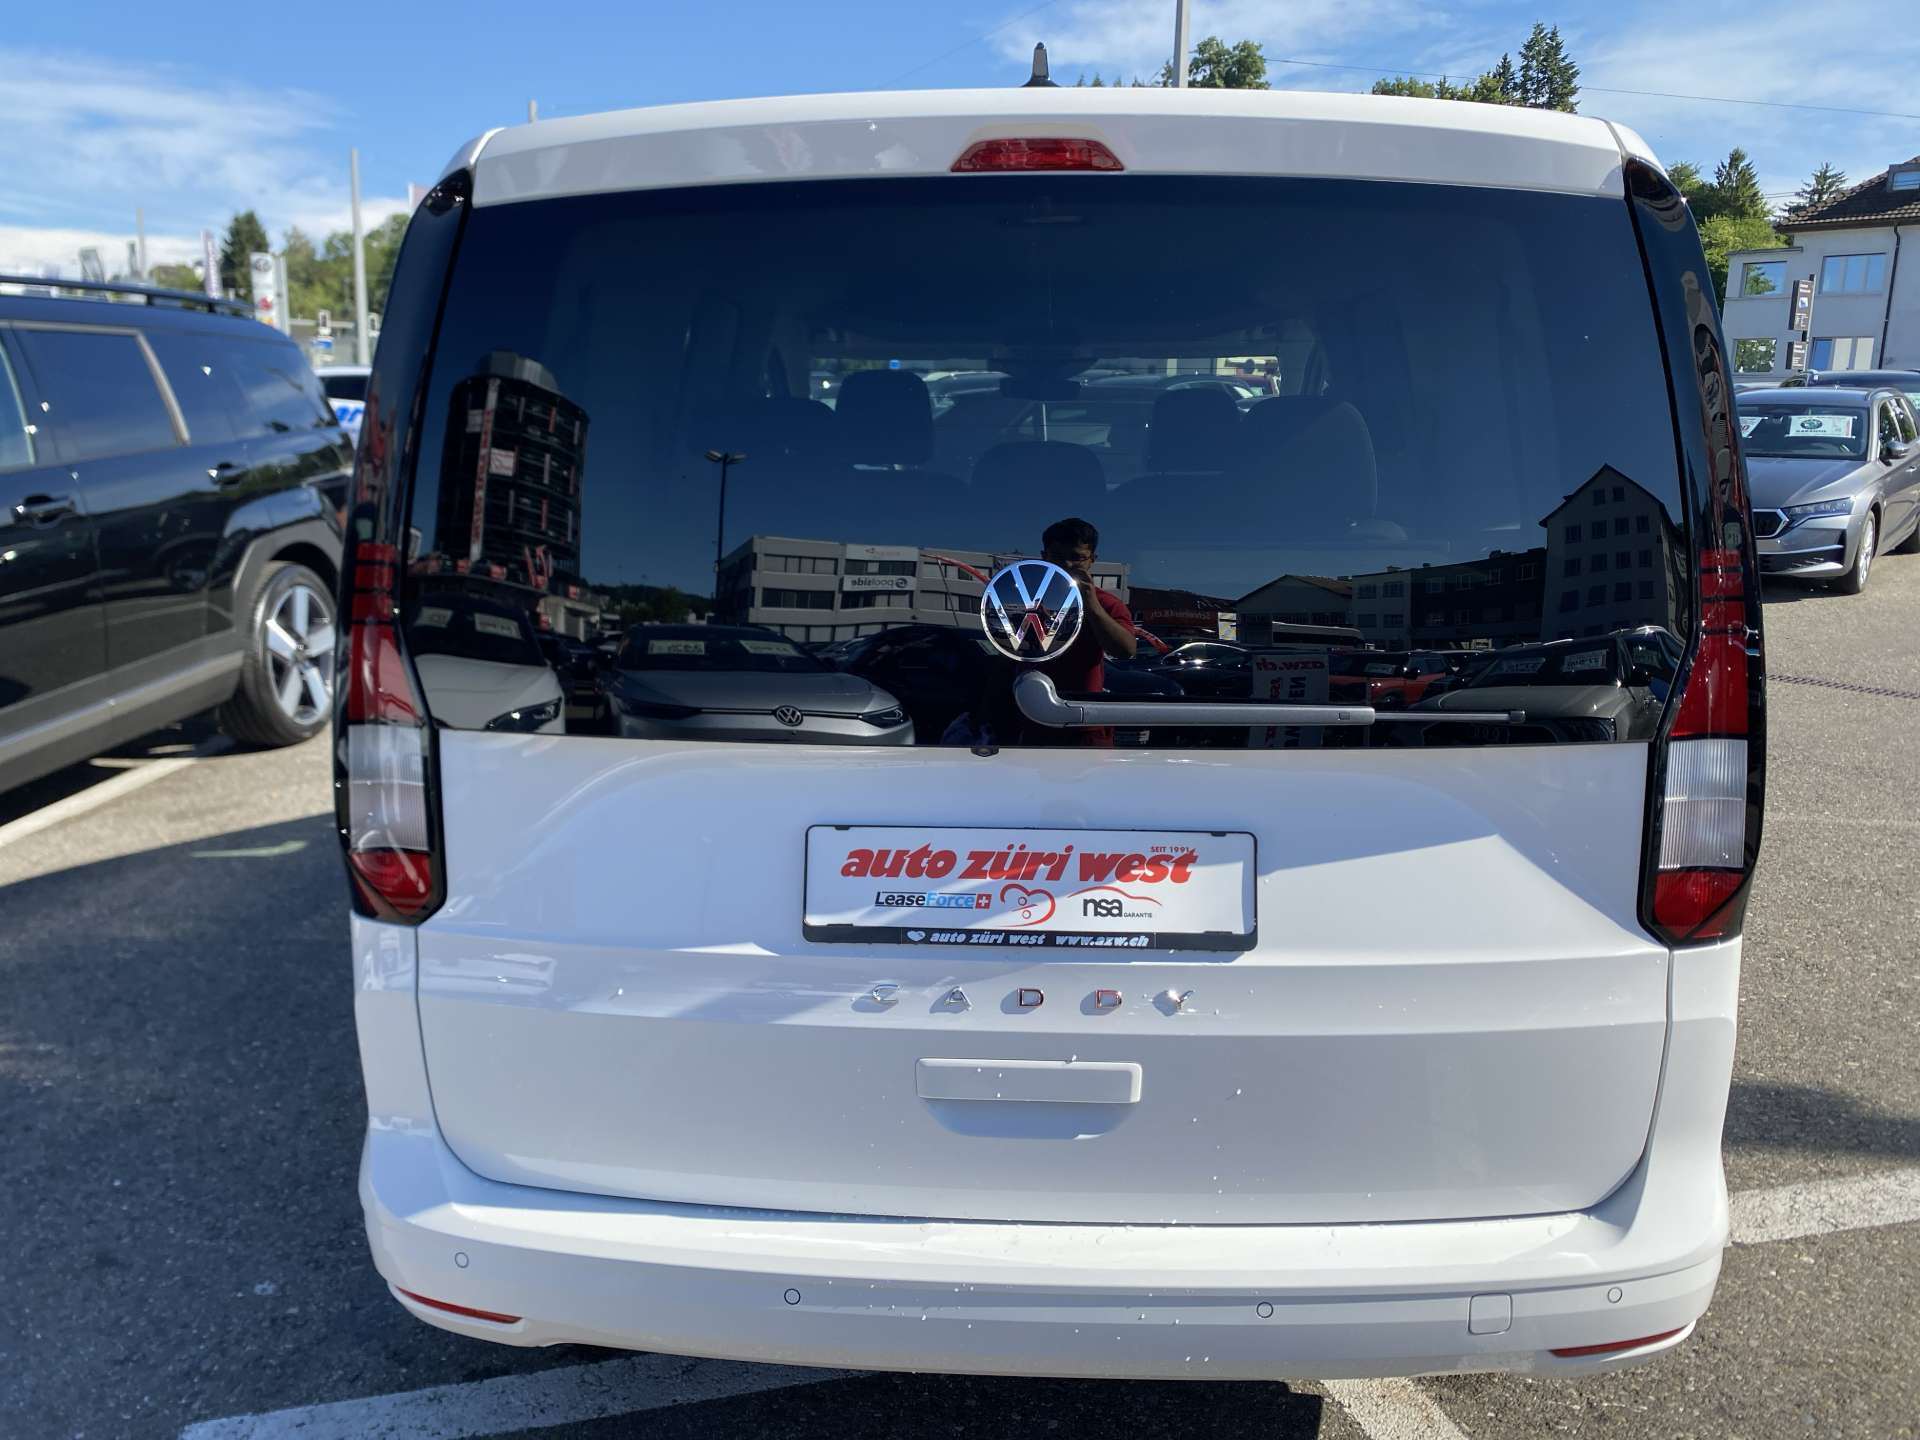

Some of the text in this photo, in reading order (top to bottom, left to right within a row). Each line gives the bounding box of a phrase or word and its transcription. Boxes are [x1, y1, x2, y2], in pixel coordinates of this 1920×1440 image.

[840, 841, 1199, 884] auto züri west
[874, 891, 976, 908] LeaseForce
[1083, 898, 1123, 918] nsa
[929, 931, 1150, 947] auto züri west www.azw.ch
[872, 984, 1195, 1011] CADDY
